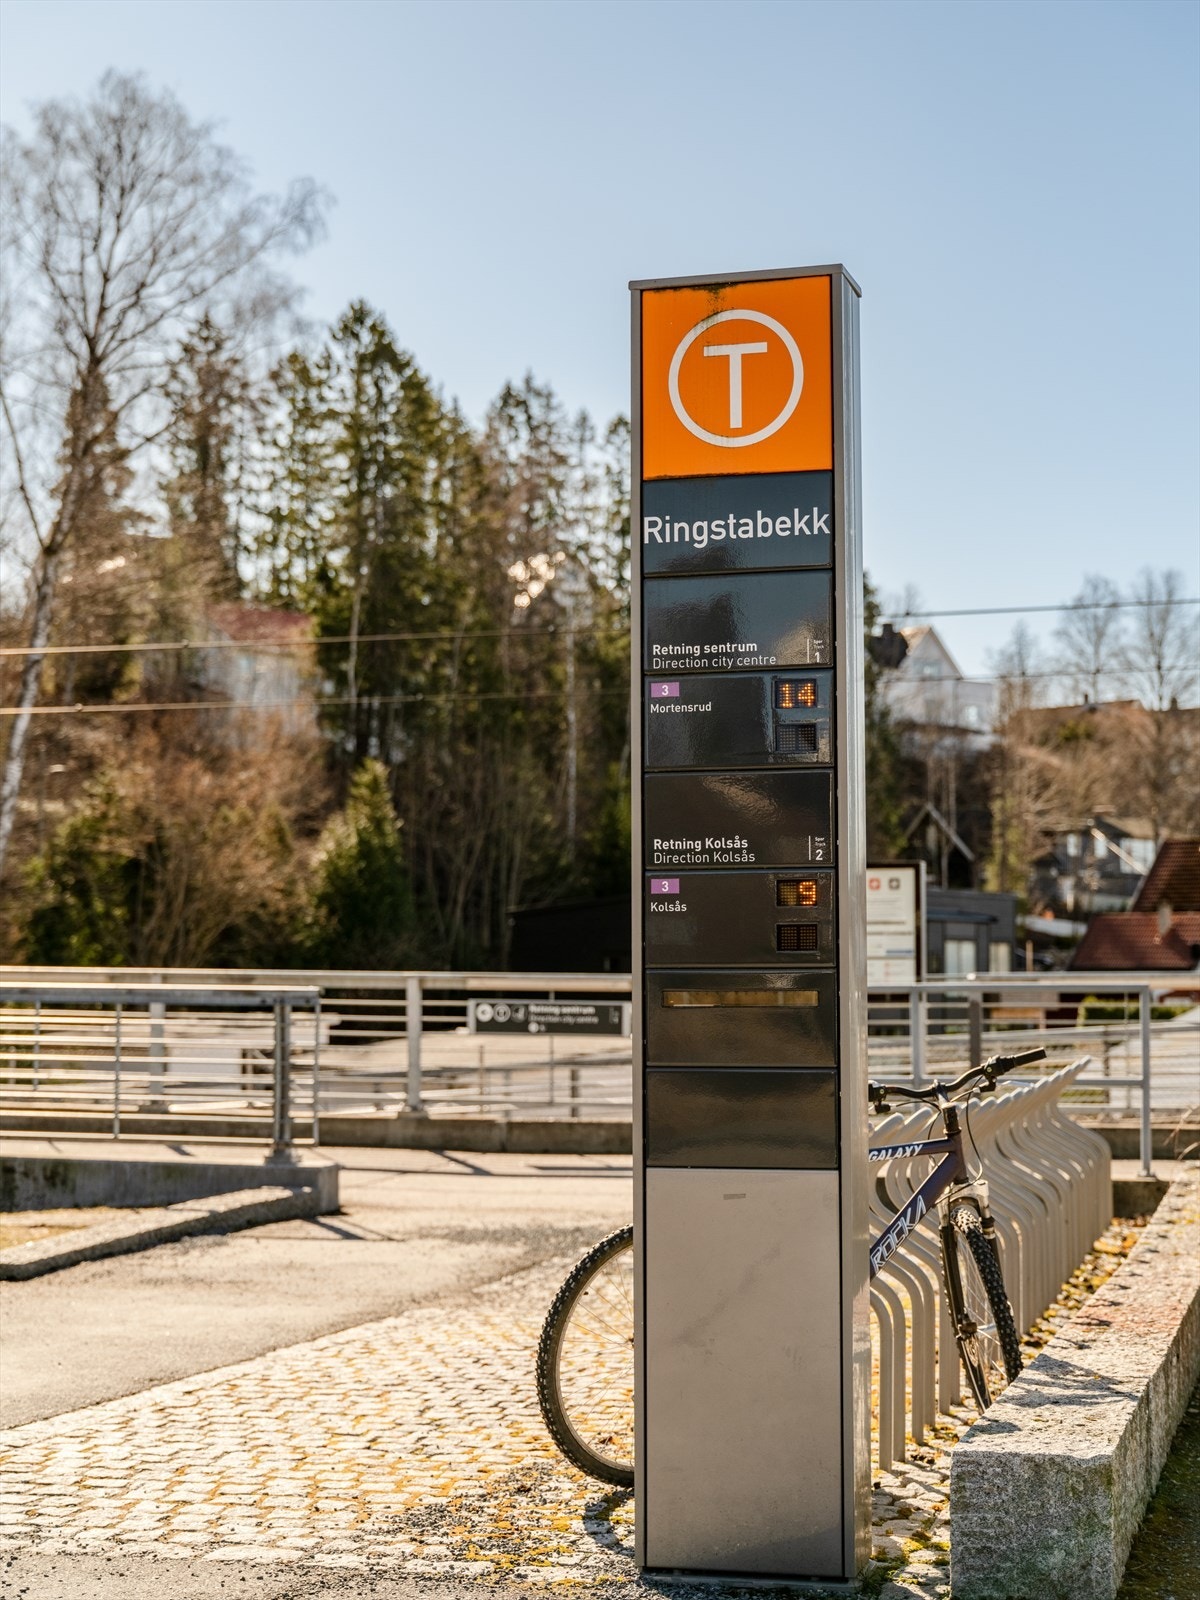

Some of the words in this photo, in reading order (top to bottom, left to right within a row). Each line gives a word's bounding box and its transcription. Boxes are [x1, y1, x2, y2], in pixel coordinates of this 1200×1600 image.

[703, 341, 768, 429] T
[643, 506, 831, 549] Ringstabekk
[652, 643, 702, 656] Retning
[703, 641, 758, 654] sentrum
[652, 656, 709, 670] Direction
[711, 656, 733, 669] city
[736, 655, 777, 666] centre
[814, 651, 820, 663] 1
[661, 685, 669, 696] 3
[781, 683, 815, 708] 14
[650, 701, 712, 714] Mortensrud
[653, 838, 702, 851] Retning
[705, 835, 749, 849] Kolsås
[653, 851, 710, 864] Direction
[713, 849, 756, 863] Kolsås
[815, 849, 823, 861] 2
[661, 881, 669, 892] 3
[799, 881, 816, 905] 9
[650, 900, 687, 912] Kolsås
[869, 1144, 924, 1162] GALAXY
